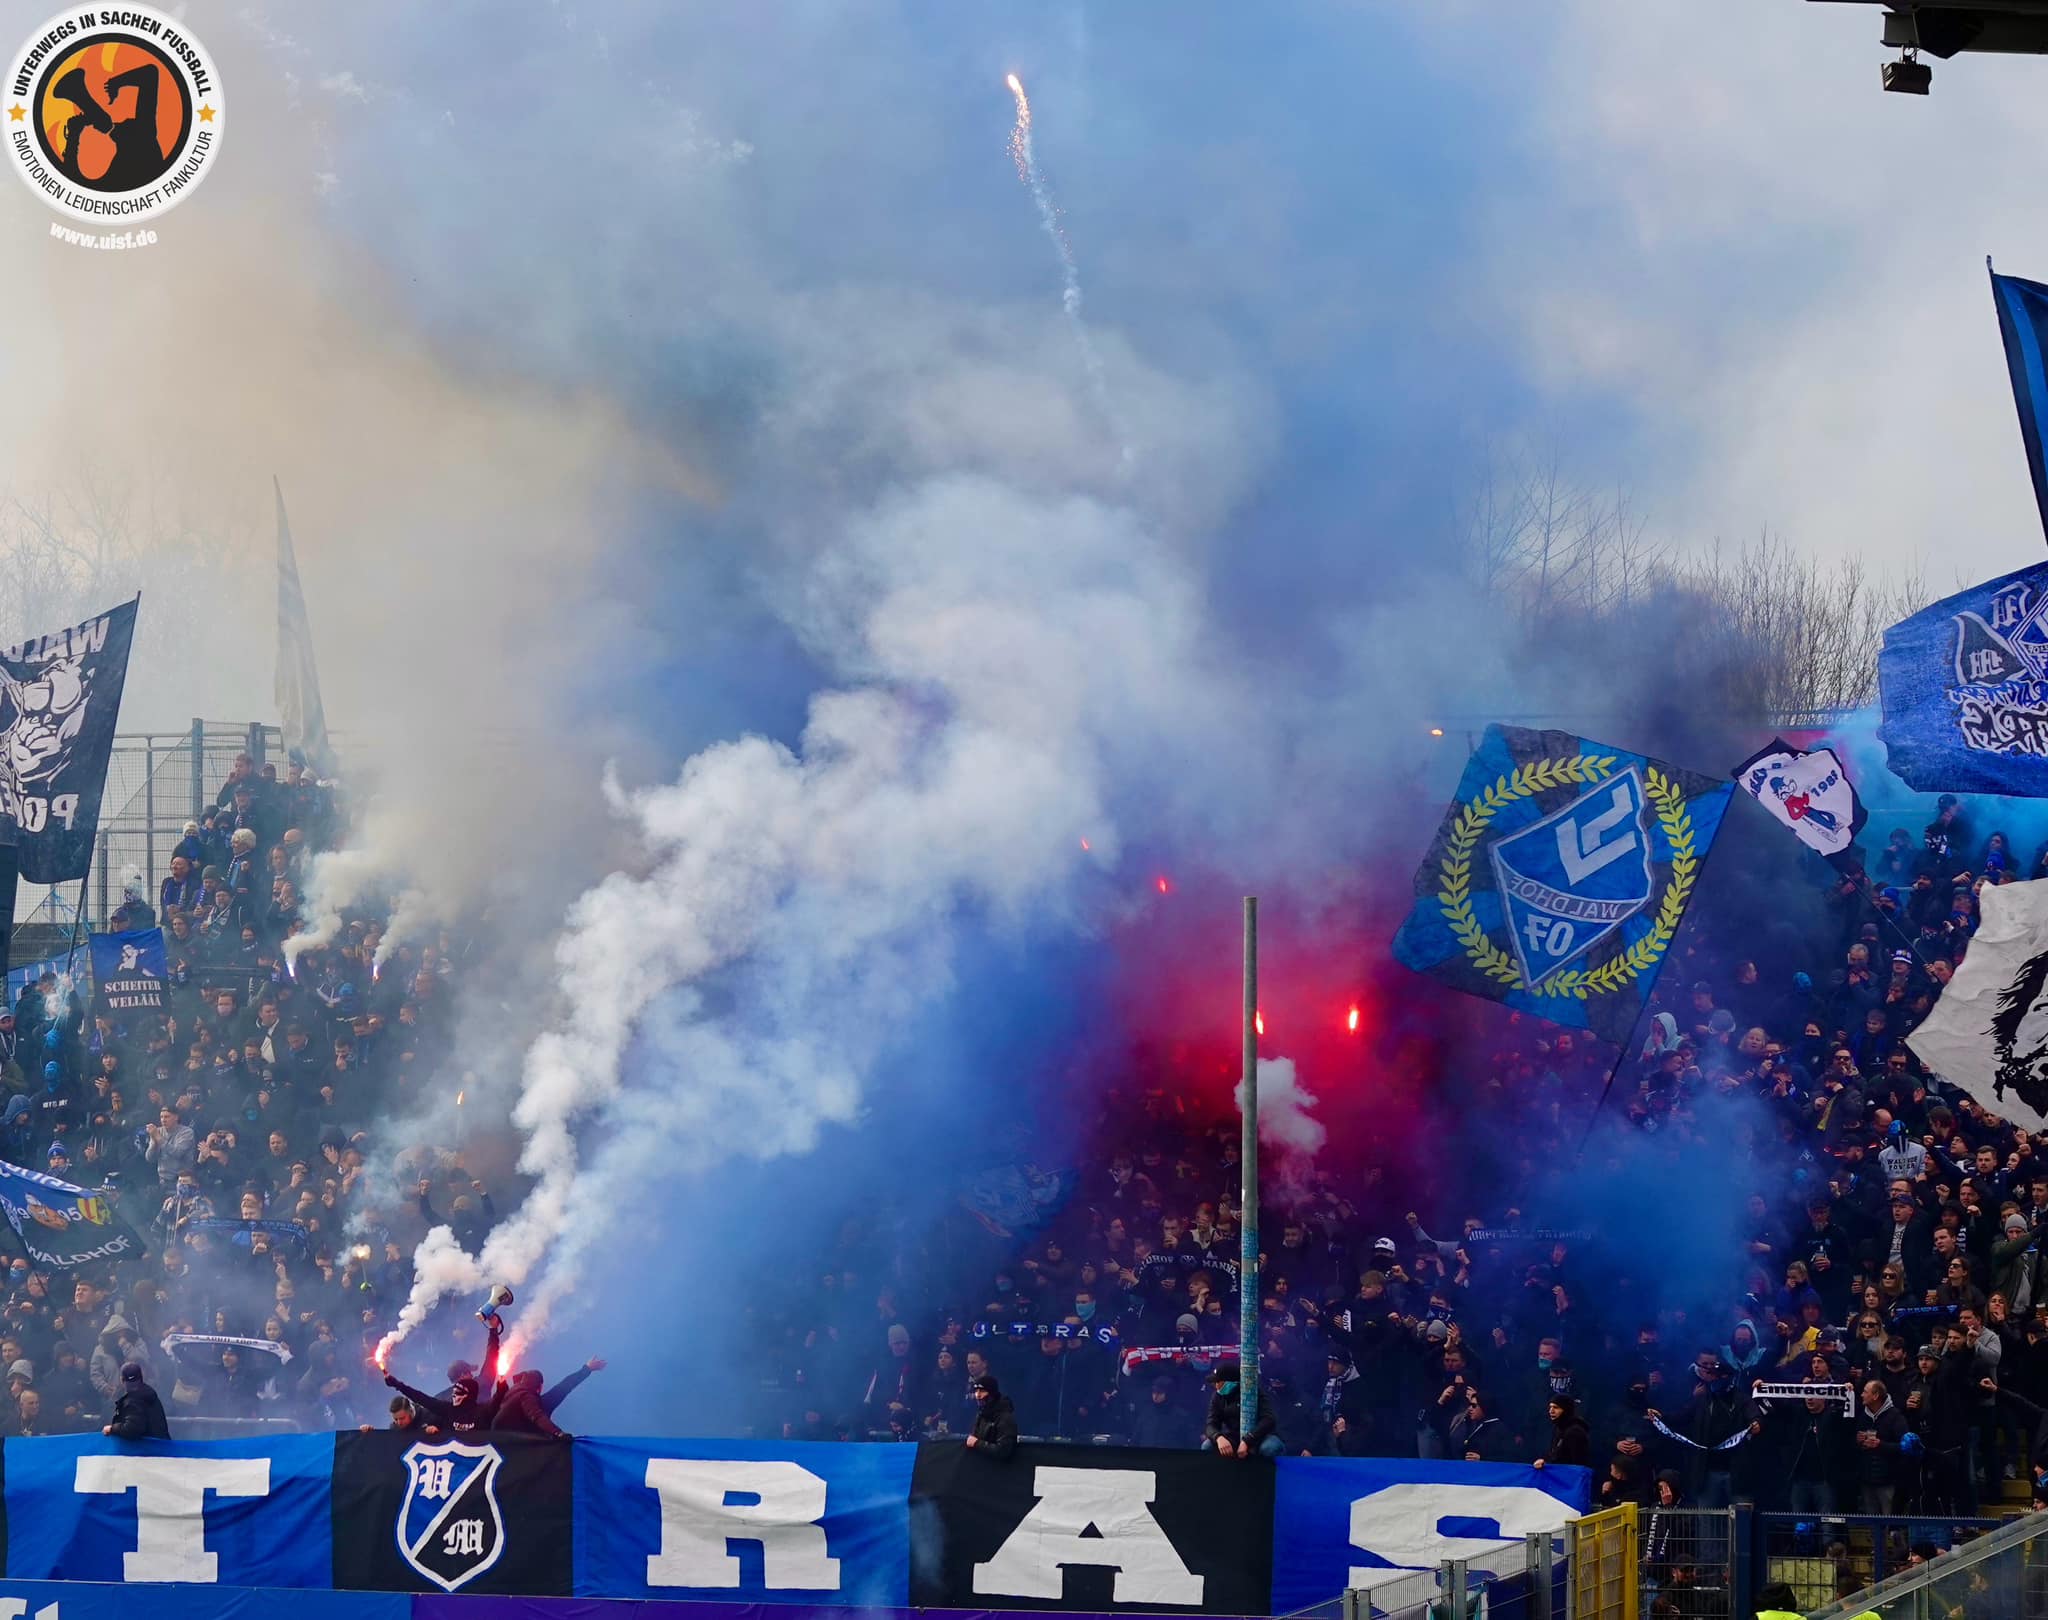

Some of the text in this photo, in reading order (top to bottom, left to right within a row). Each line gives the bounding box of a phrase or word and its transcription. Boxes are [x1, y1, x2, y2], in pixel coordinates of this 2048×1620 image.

[104, 981, 161, 993] SCHEITER
[25, 1235, 131, 1266] WALDHOF
[1757, 1385, 1848, 1397] Eintracht
